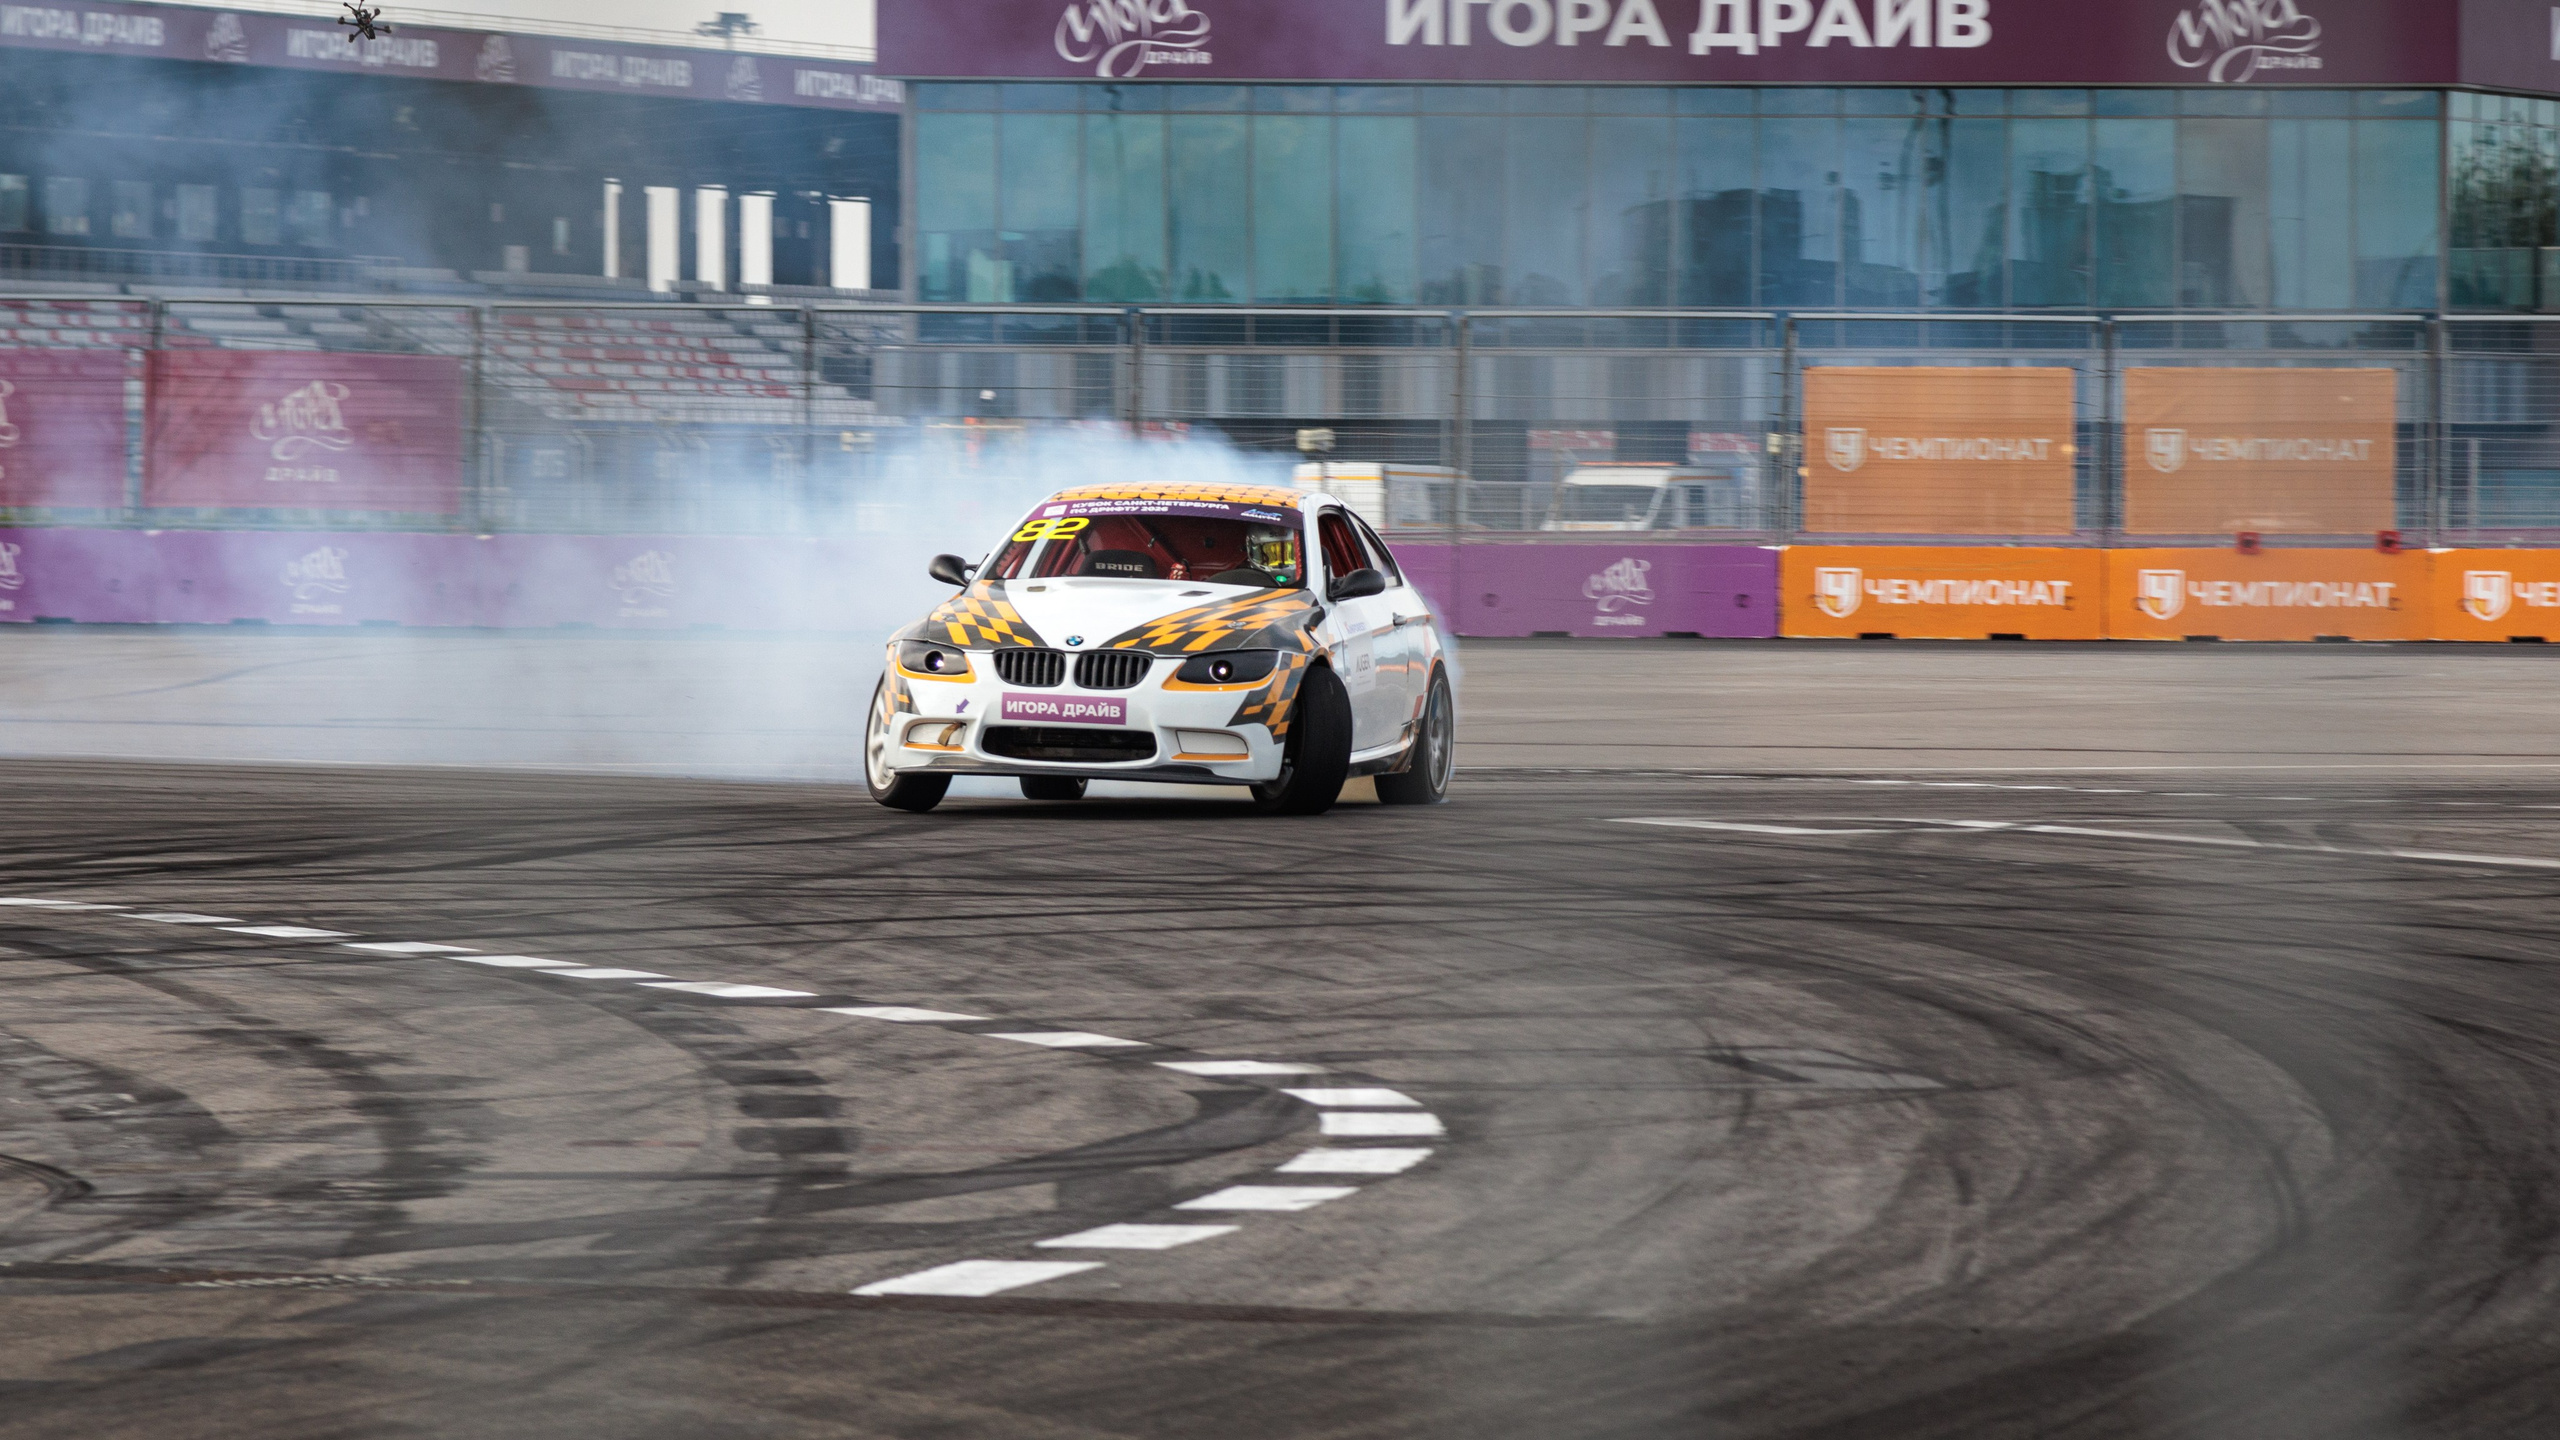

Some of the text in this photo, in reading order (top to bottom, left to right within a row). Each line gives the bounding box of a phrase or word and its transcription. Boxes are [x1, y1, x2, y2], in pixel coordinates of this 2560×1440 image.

[1384, 0, 1673, 48] ИГОРА
[1868, 437, 2053, 461] ЧЕМПИОНАТ
[2188, 437, 2374, 461] ЧЕМПИОНАТ
[1072, 500, 1230, 510] КУБОК САНКТ-ПЕТЕРБУРГА
[1088, 506, 1140, 514] ДРИФТУ
[1011, 517, 1090, 543] 82
[1095, 562, 1144, 572] BRIDE
[1863, 578, 2072, 606] ЧЕМПИОНАТ
[2186, 580, 2397, 607] ЧЕМПИОНАТ
[2513, 581, 2560, 607] ЧЕ
[1006, 700, 1121, 718] ИГОРА ДРАЙВ
